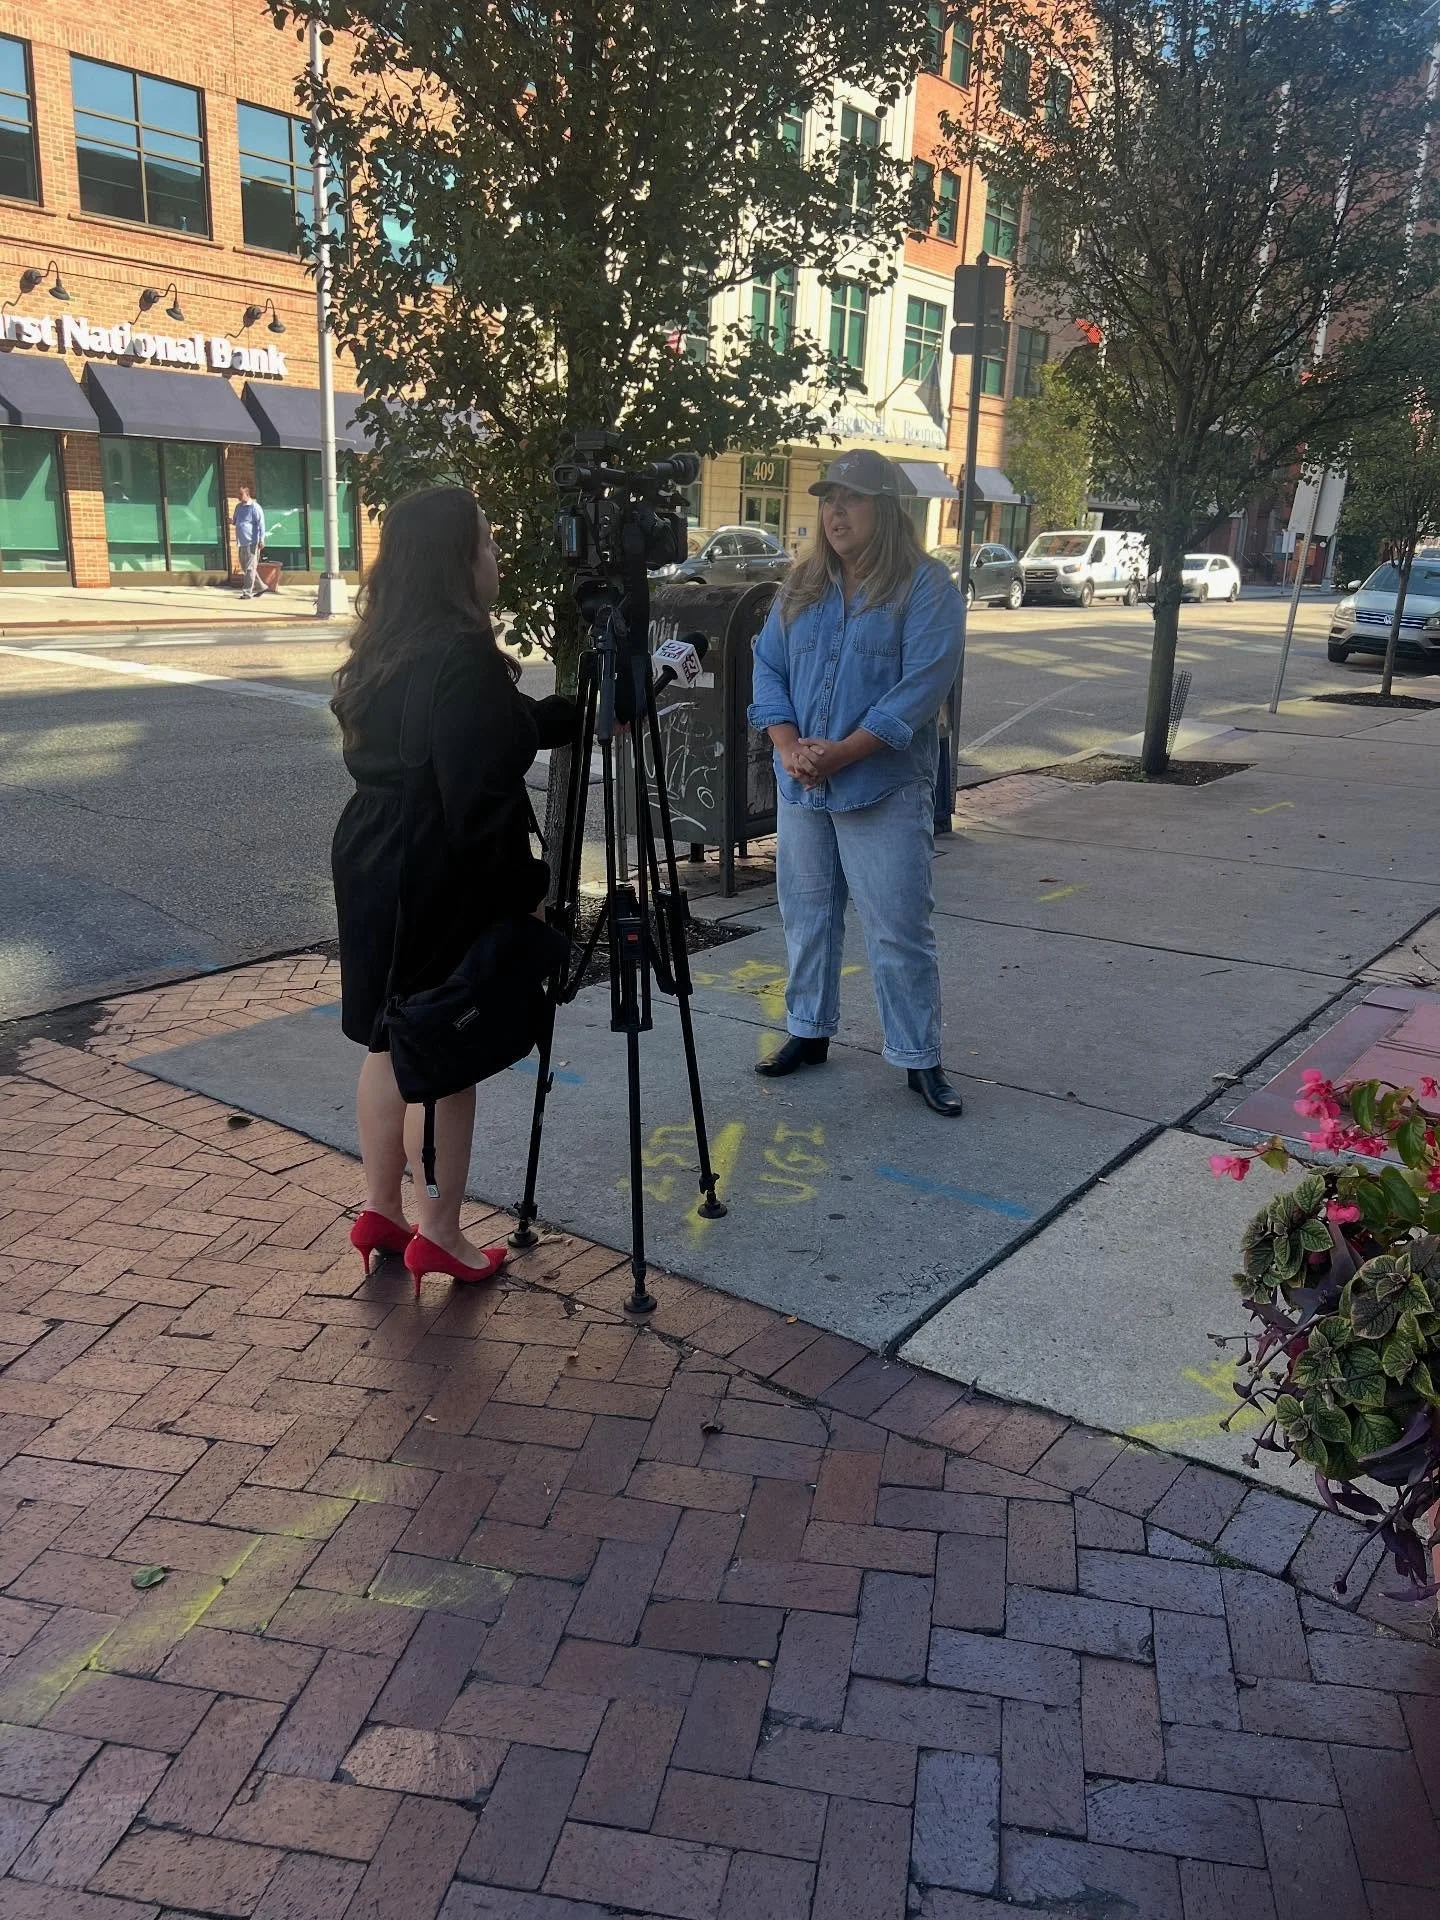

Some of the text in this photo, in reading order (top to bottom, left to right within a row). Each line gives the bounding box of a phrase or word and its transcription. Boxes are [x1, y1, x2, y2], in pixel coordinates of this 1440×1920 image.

[62, 315, 205, 363] National
[211, 337, 288, 376] Bank
[753, 461, 775, 481] 409
